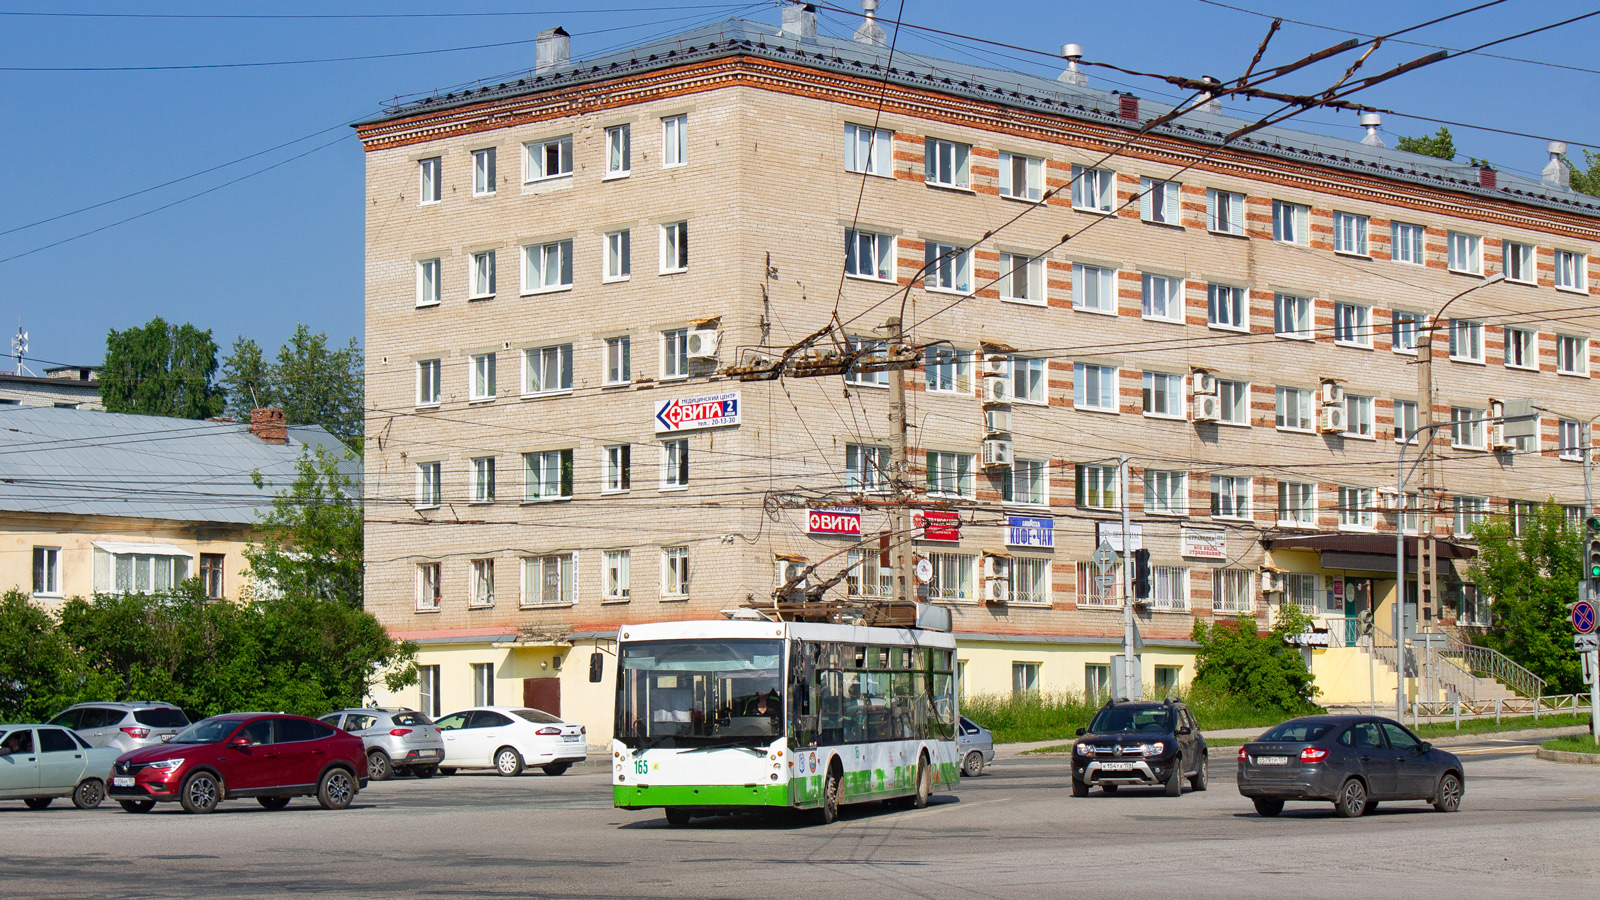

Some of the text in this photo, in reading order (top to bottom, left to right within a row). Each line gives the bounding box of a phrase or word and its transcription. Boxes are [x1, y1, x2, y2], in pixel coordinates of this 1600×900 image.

[681, 396, 719, 404] МЕДИЦИНСКИЙ
[726, 401, 734, 412] 2
[711, 417, 736, 426] 20-13-30
[634, 760, 648, 774] 165
